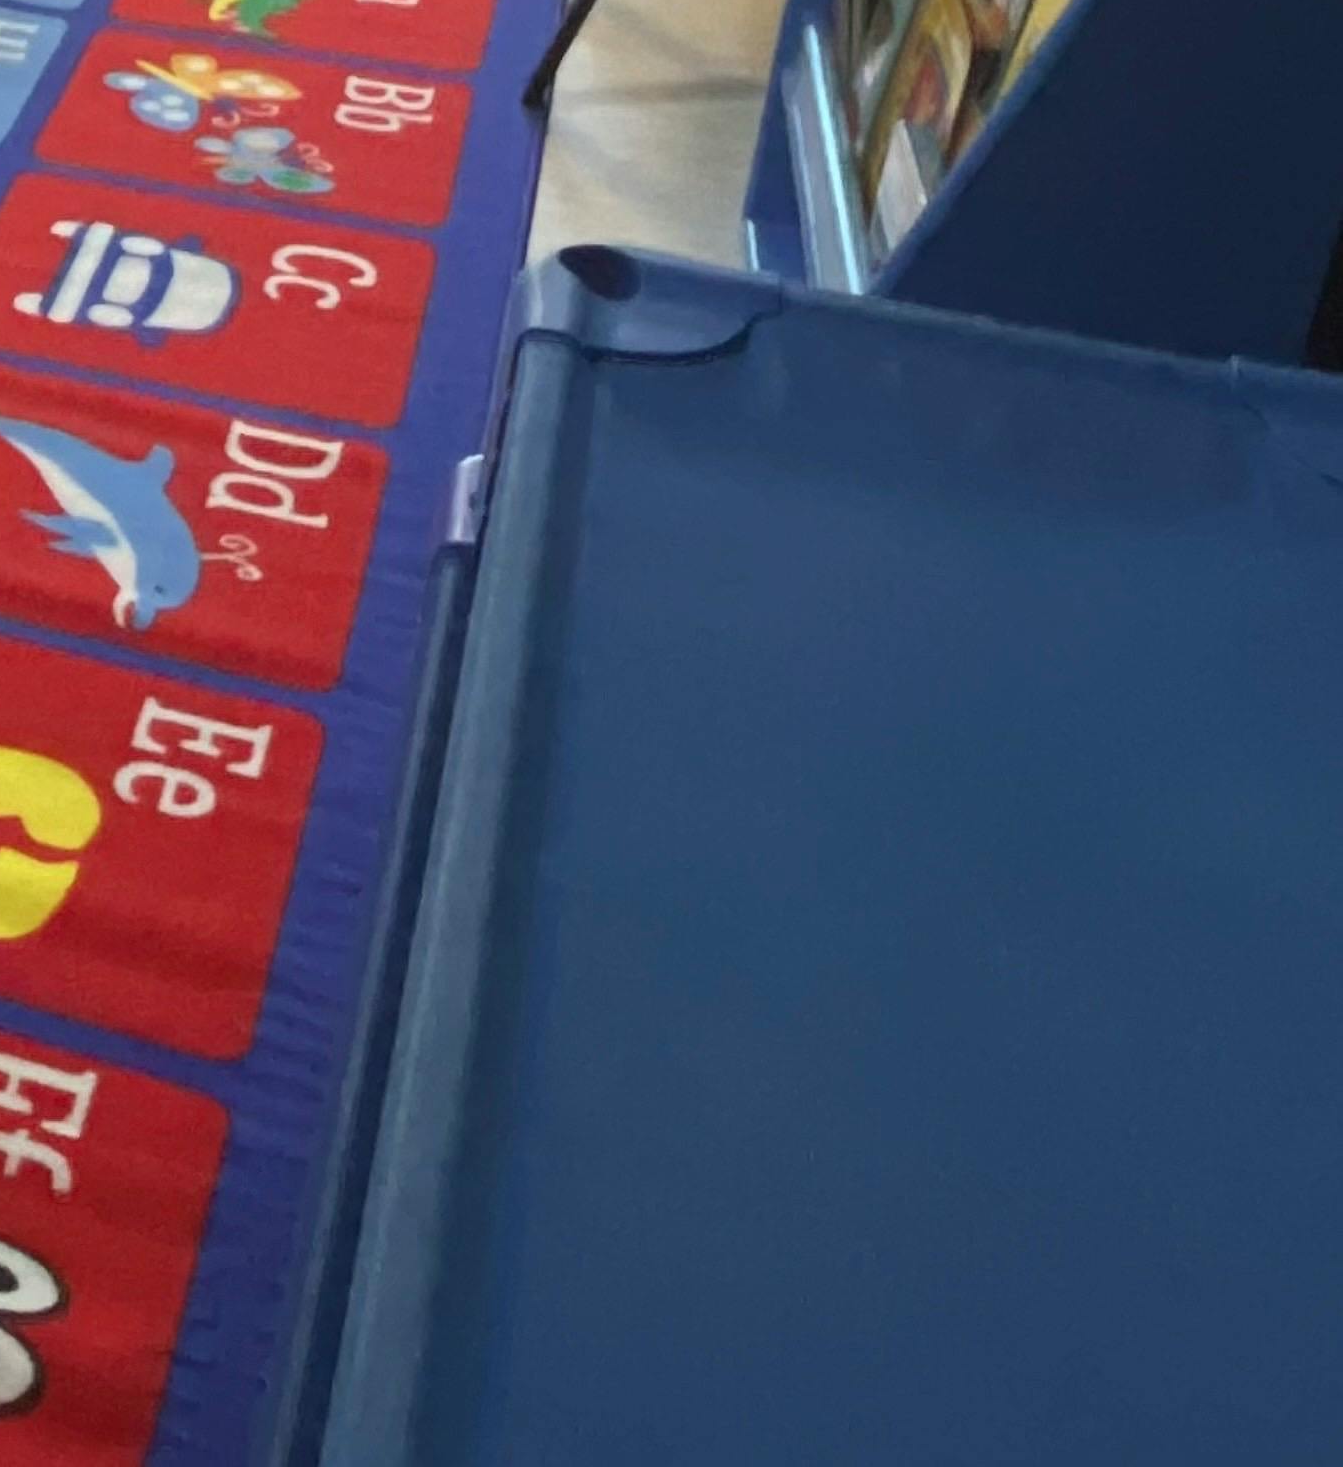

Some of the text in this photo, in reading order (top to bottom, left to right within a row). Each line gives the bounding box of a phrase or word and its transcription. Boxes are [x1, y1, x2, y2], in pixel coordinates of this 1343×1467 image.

[334, 75, 436, 134] Bb
[263, 244, 378, 310] Cc
[205, 419, 345, 529] Dd
[113, 696, 273, 819] Ee
